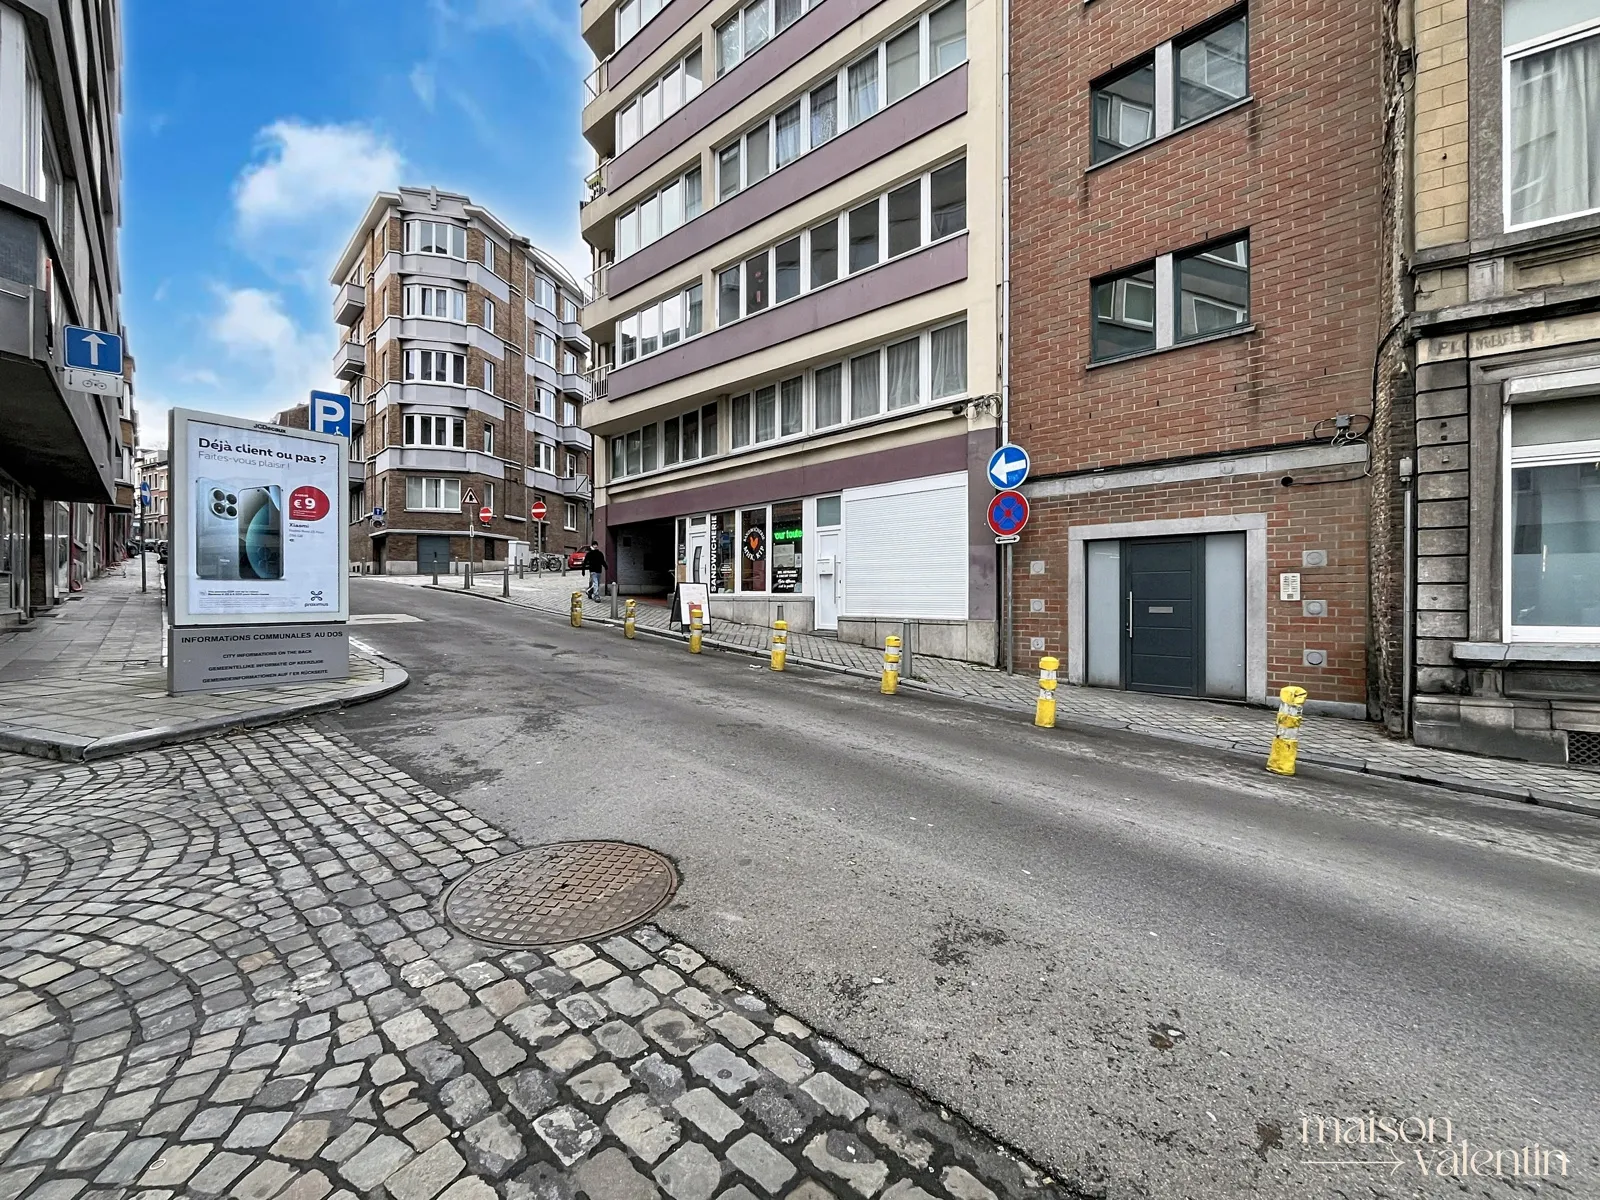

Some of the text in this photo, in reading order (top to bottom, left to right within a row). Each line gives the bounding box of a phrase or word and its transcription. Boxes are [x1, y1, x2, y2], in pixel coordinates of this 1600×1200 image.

[315, 398, 345, 433] P
[253, 423, 287, 434] JCDecaux
[198, 437, 327, 464] Déjà client ou pas ?
[198, 450, 257, 466] Faites-vous
[258, 459, 286, 469] plaisir
[181, 634, 251, 644] INFORMATIONS
[253, 632, 311, 641] COMMUNALES
[327, 630, 343, 638] DOS
